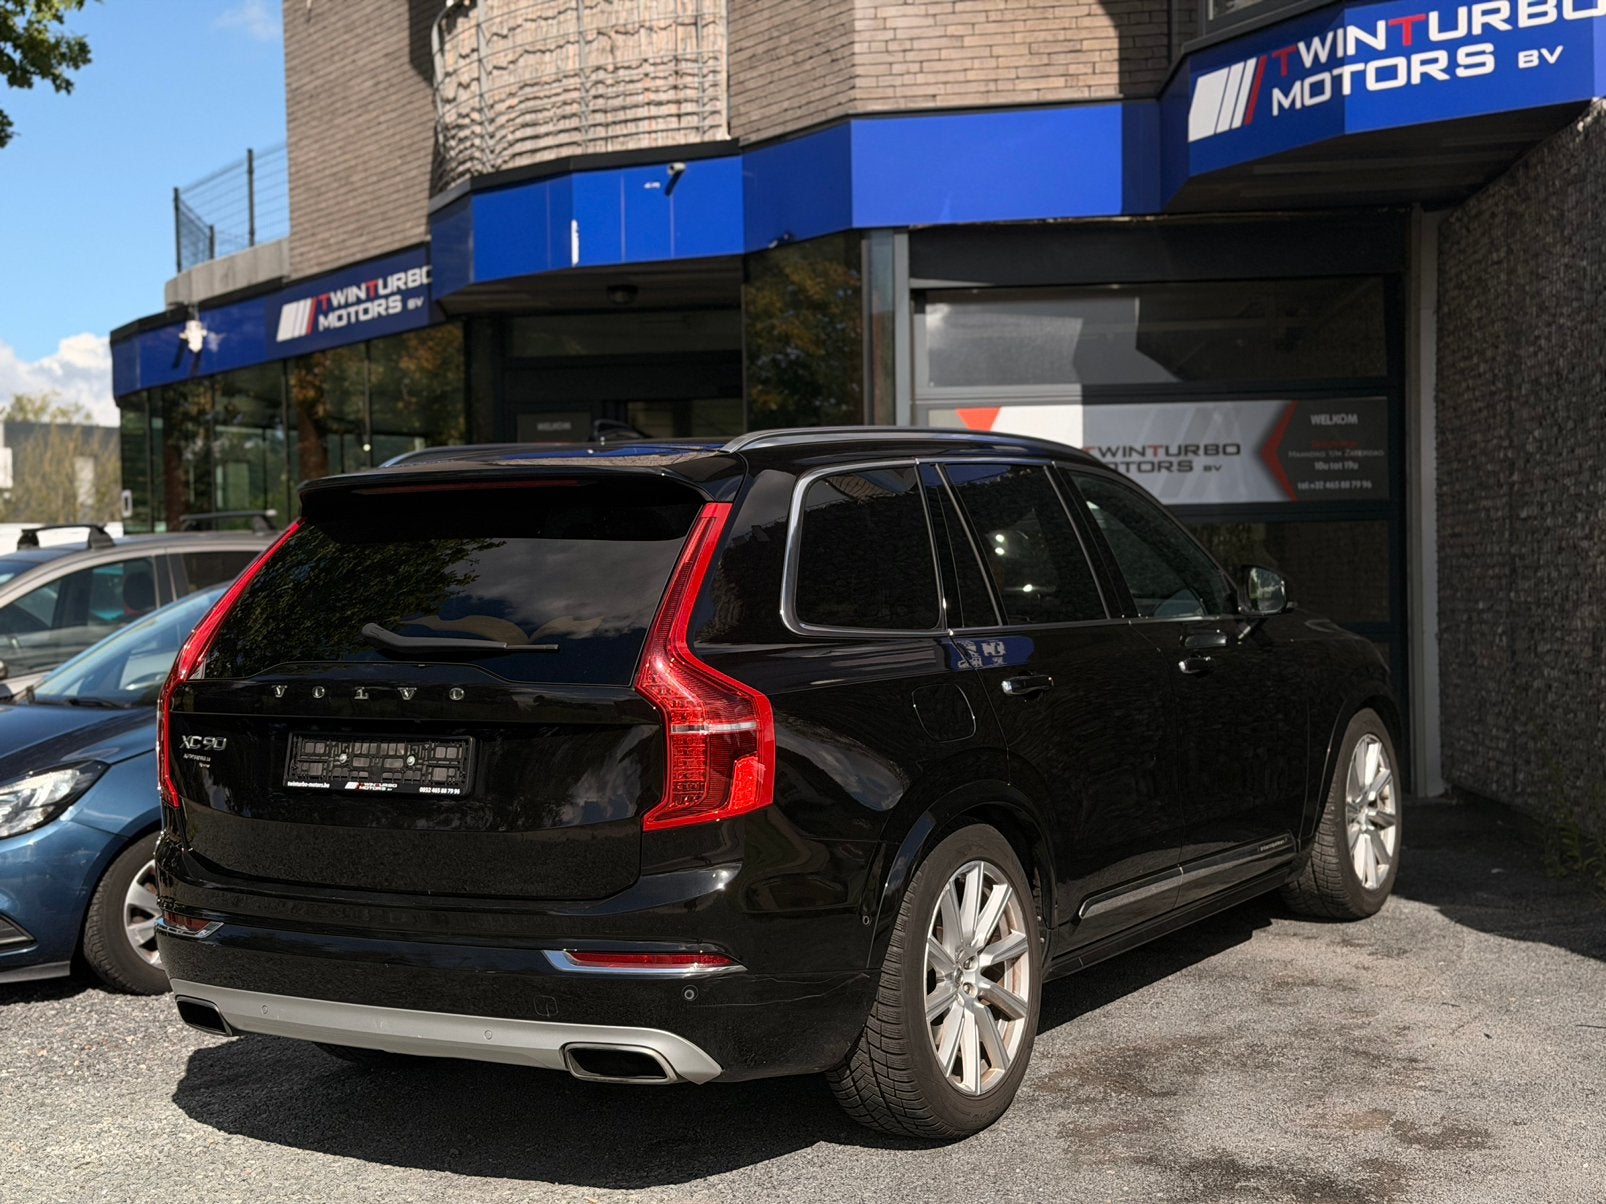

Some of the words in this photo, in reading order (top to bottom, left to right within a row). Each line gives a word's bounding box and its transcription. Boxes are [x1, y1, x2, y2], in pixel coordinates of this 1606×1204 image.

[1272, 0, 1606, 76] TWINTURBO
[1272, 43, 1495, 117] MOTORS
[1518, 45, 1564, 69] BV
[318, 295, 402, 332] MOTORS
[1310, 413, 1359, 426] WELKOM
[270, 684, 466, 701] VOLVO
[179, 735, 227, 751] XC90
